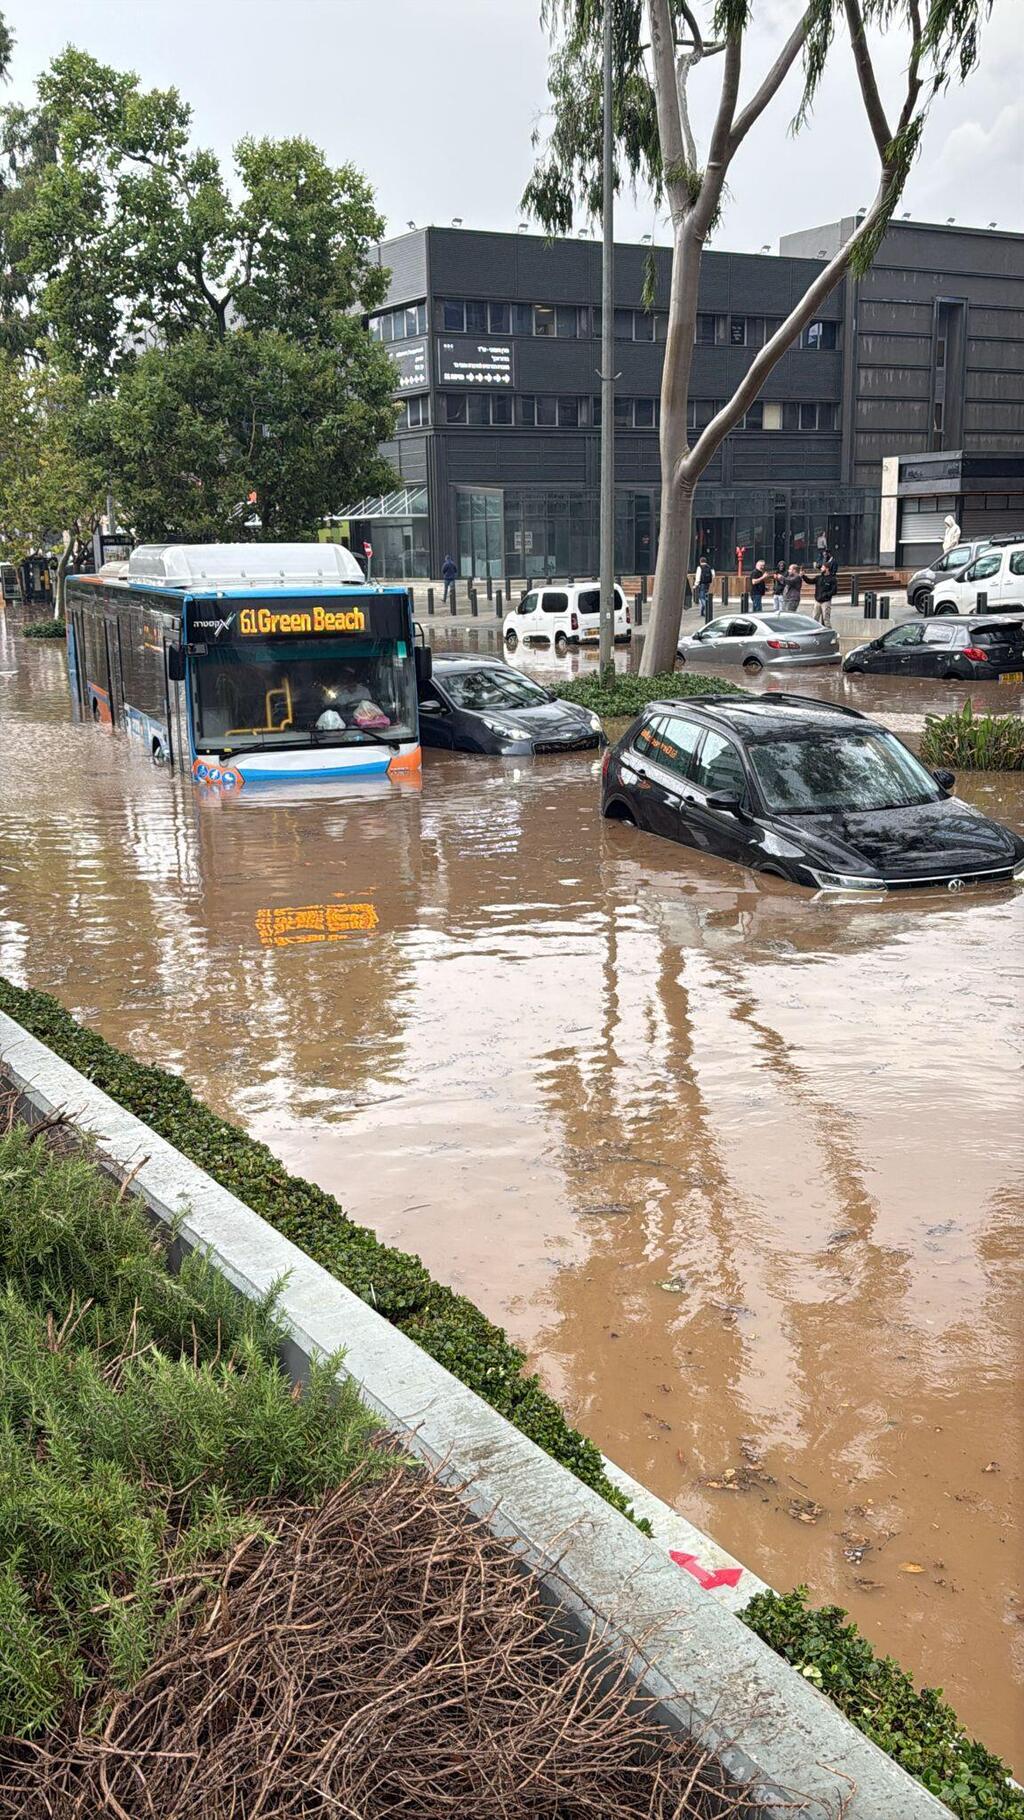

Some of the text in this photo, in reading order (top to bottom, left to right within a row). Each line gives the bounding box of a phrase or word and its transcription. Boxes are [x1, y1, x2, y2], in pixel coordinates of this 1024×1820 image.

[240, 606, 365, 634] 61 Green Beach
